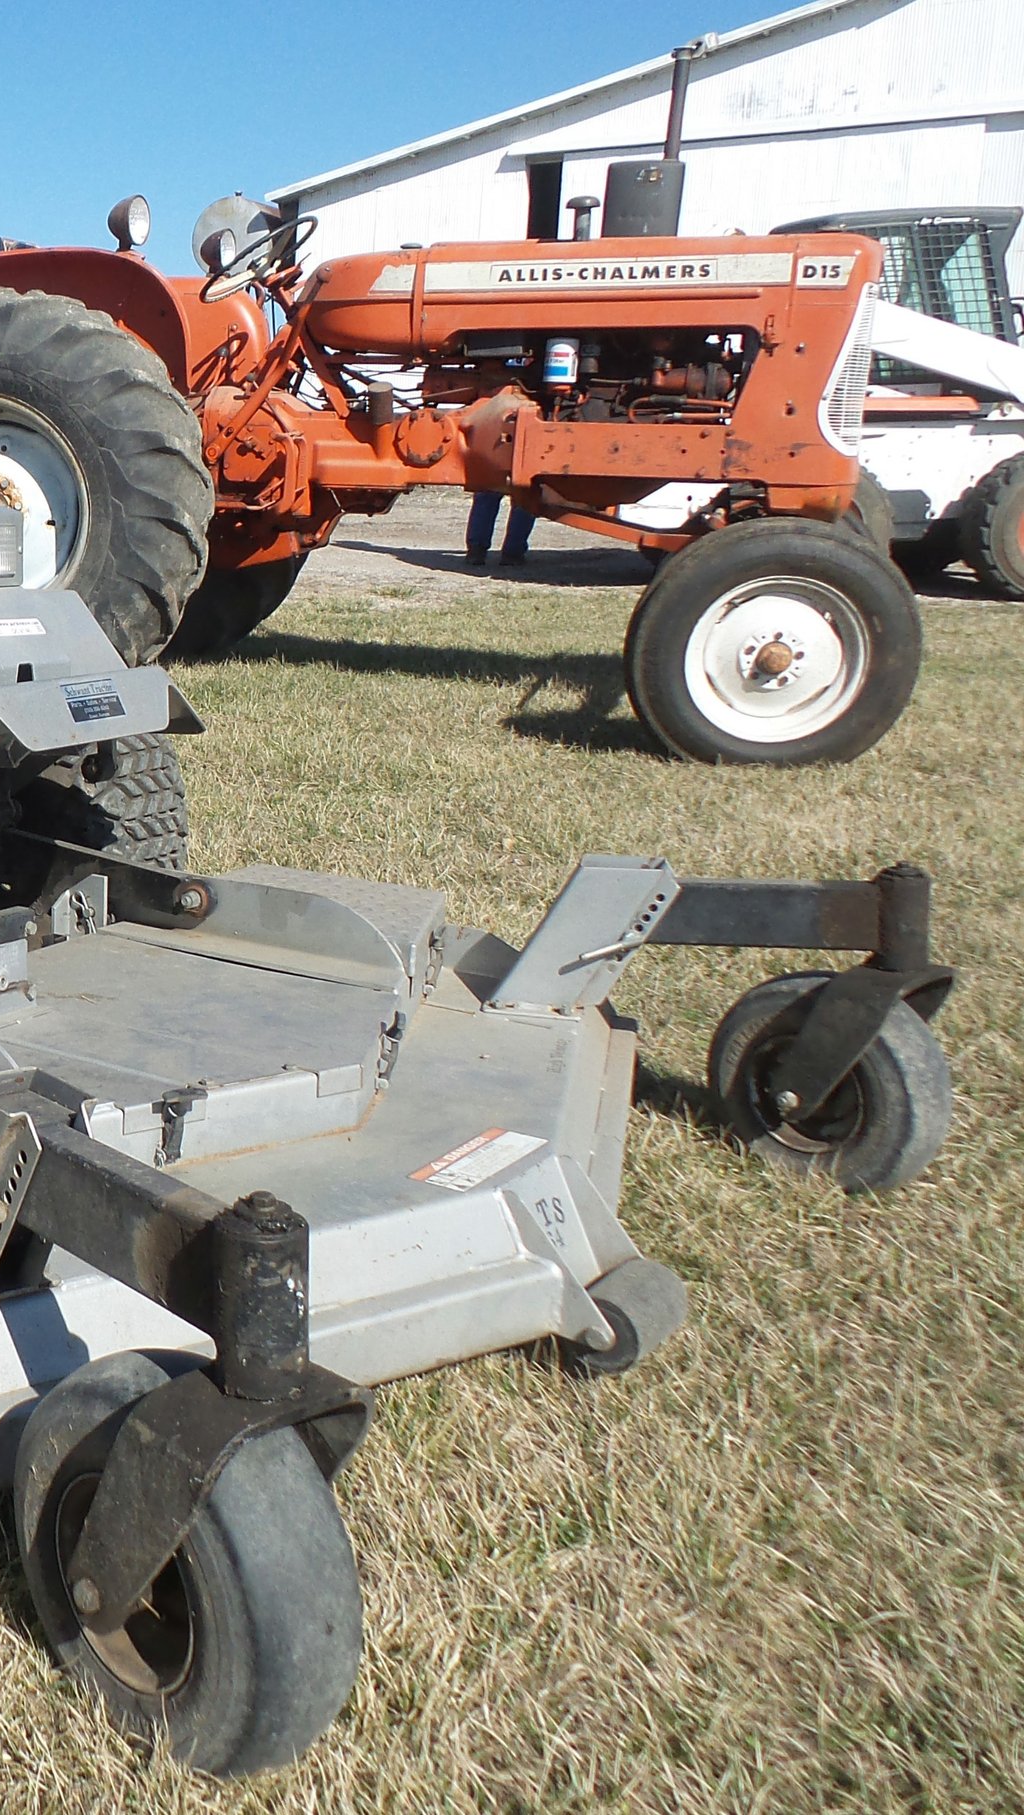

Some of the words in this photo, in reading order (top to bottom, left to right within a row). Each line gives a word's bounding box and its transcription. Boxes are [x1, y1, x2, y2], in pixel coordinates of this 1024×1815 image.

[498, 264, 711, 282] ALLIS-CHALMERS
[802, 265, 841, 279] D15
[442, 1136, 490, 1161] DANGER
[535, 1197, 565, 1227] TS
